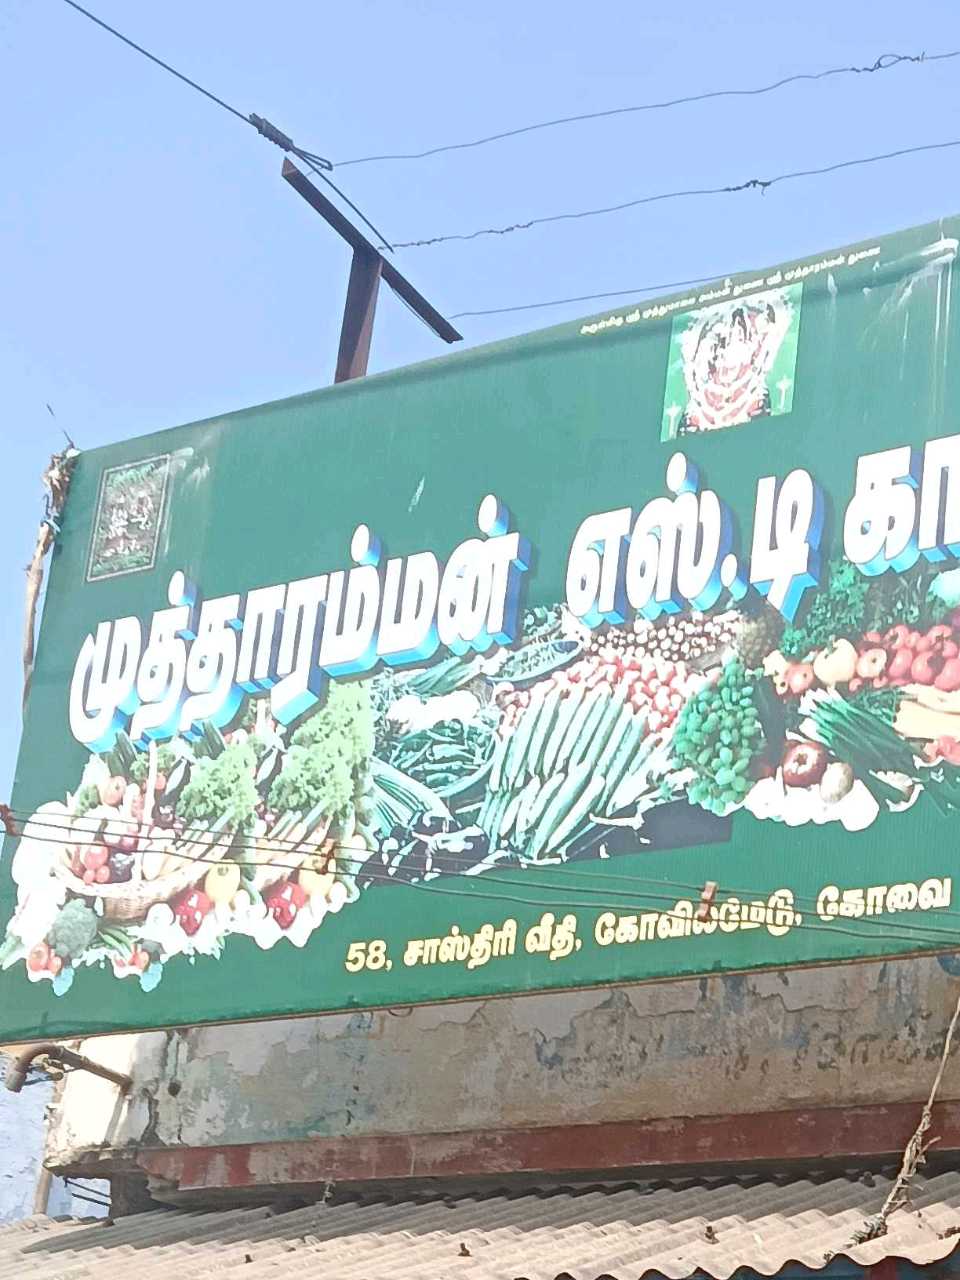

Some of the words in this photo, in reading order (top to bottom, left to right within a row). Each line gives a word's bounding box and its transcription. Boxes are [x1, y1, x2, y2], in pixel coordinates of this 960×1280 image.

[68, 494, 531, 753] முத்தாரம்மன்
[565, 452, 825, 622] எஸ்.டி
[344, 941, 393, 974] 58,
[402, 920, 516, 970] சாஸ்திரி
[525, 913, 582, 961] வீதி,
[816, 879, 952, 922] கோவை
